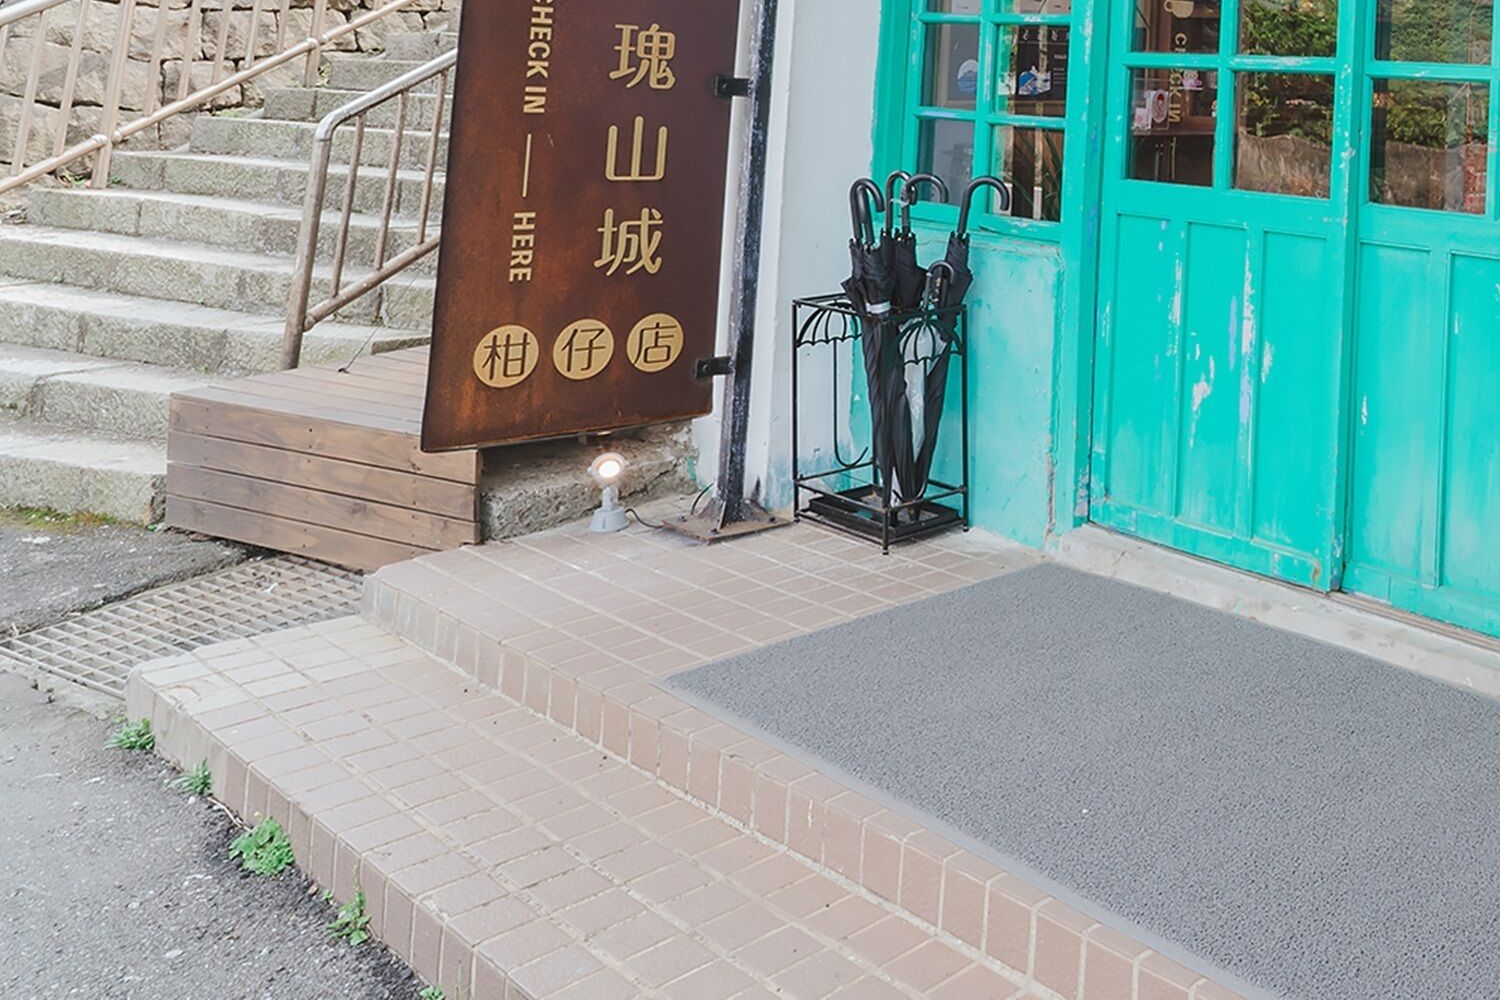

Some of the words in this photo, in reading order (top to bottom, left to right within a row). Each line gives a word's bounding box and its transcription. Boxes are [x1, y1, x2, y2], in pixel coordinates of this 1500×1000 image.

[523, 86, 548, 114] IN
[508, 211, 537, 283] HERE
[480, 319, 679, 382] 柑仔店
